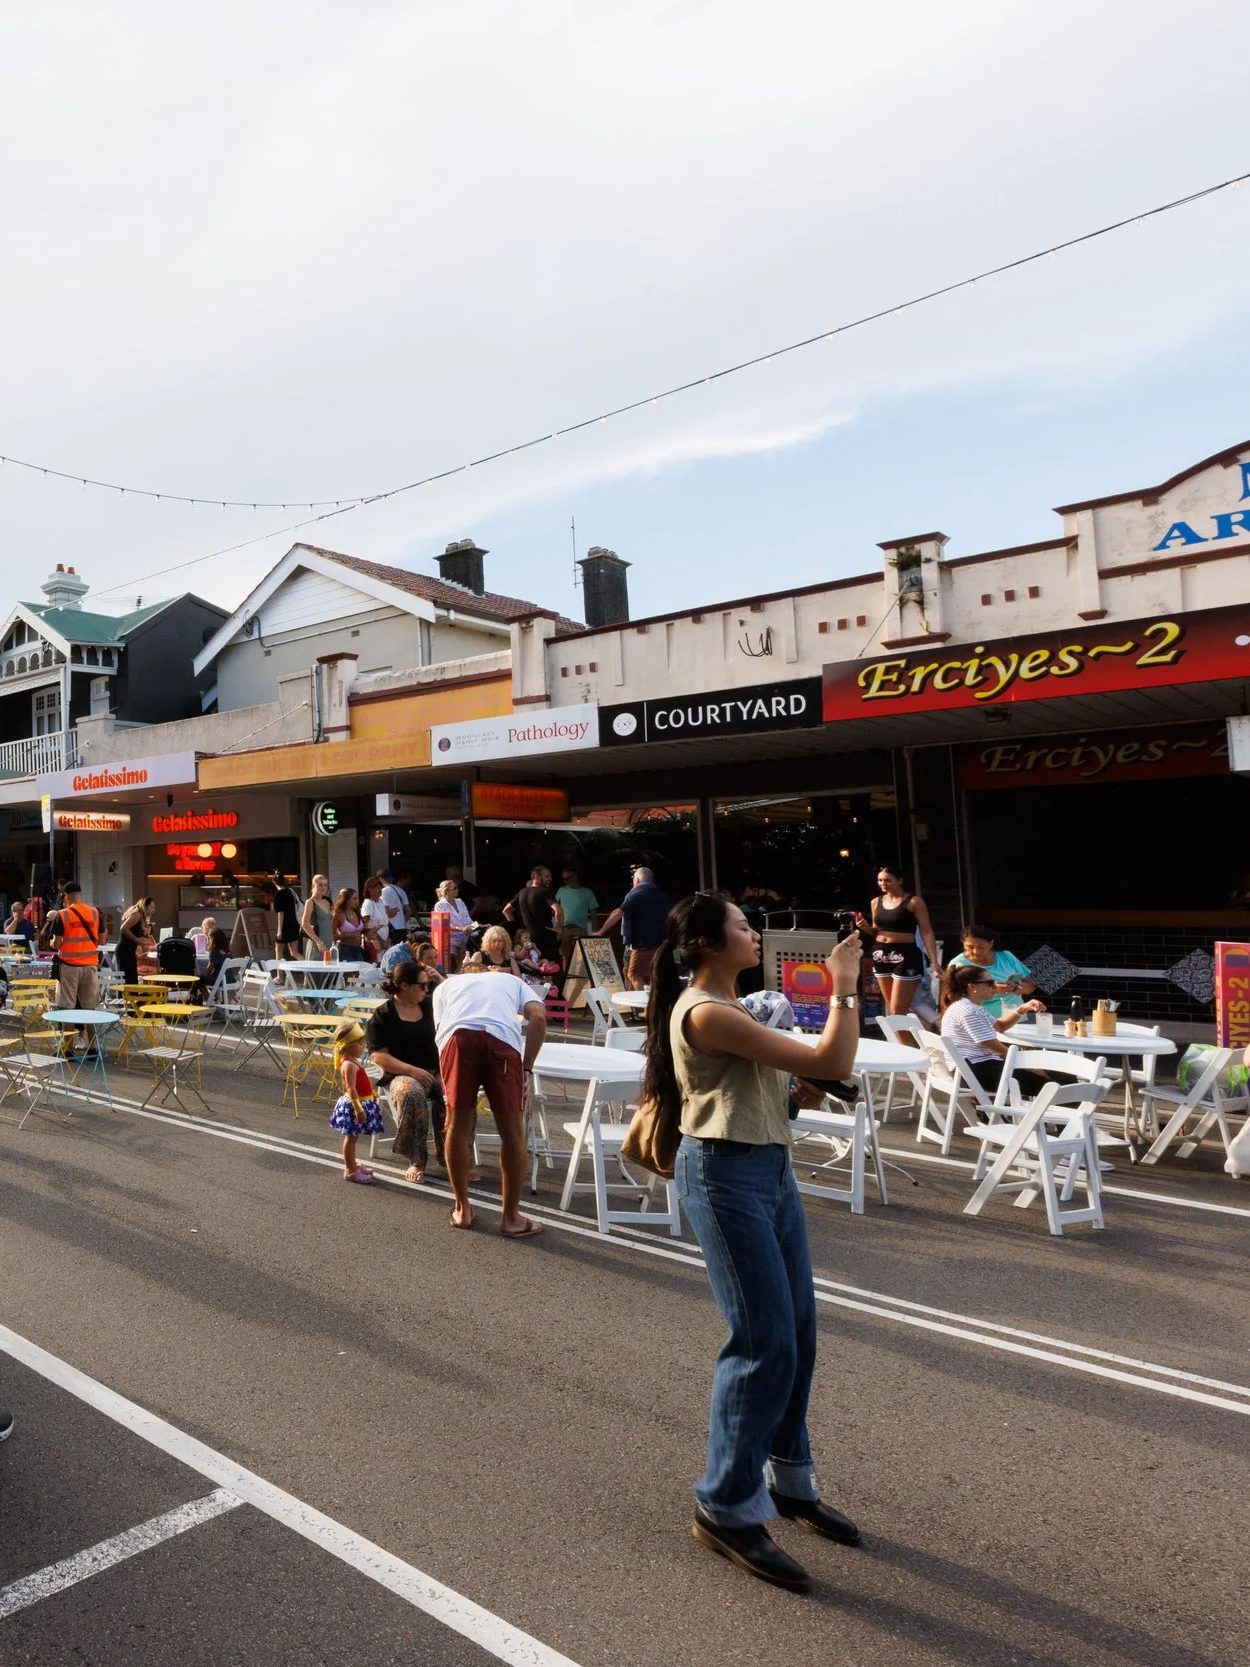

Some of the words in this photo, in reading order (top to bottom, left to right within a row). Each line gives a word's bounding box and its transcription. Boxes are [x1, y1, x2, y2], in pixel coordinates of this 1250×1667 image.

[654, 694, 807, 731] COURTYARD
[507, 721, 589, 744] Pathology
[72, 766, 148, 792] Gelatissimo
[58, 814, 122, 830] Gelatissimo
[151, 807, 238, 833] Gelatissimo
[582, 939, 610, 950] HAPPY
[588, 949, 611, 961] HOUR
